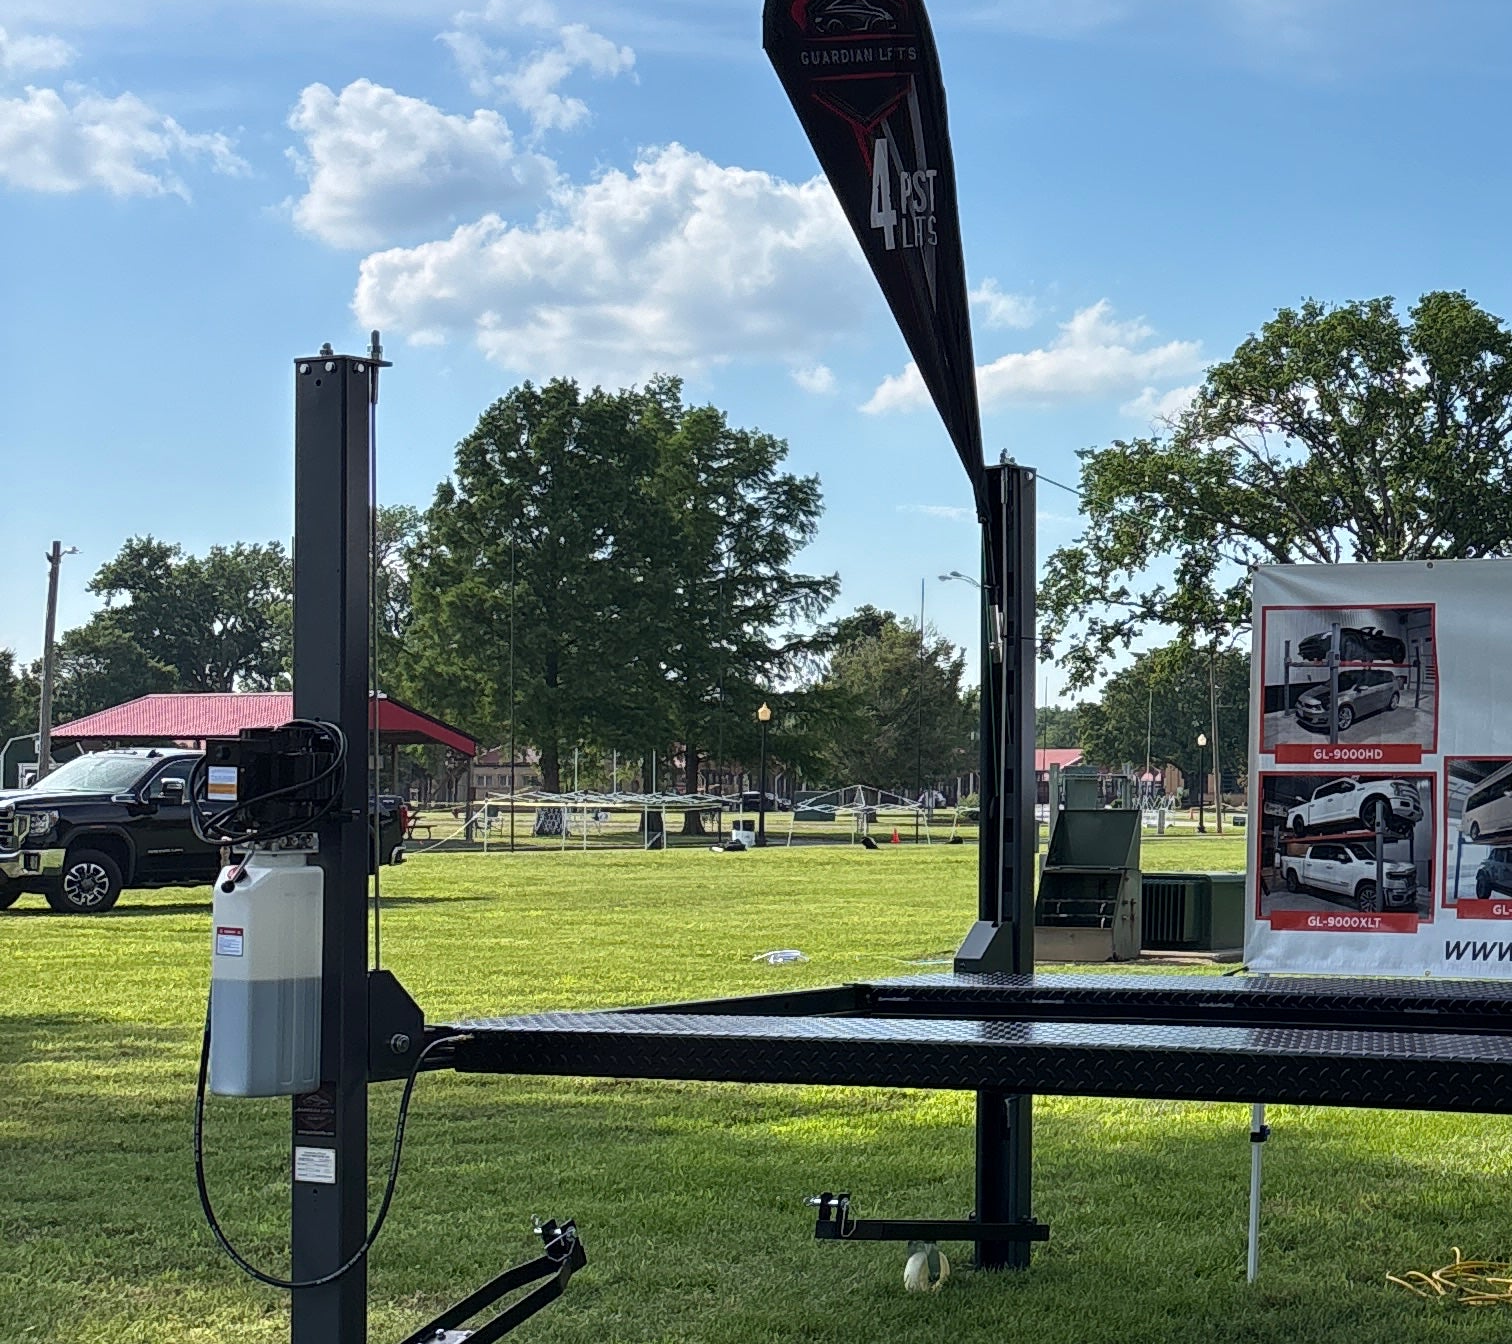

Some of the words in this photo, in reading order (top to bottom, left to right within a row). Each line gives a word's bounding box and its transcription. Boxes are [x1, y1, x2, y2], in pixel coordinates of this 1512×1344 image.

[800, 47, 873, 65] GUARDIAN
[870, 138, 898, 251] 4
[900, 169, 938, 215] PST
[1313, 748, 1384, 760] GL-9000HD
[1307, 915, 1382, 929] GL-9000XLT
